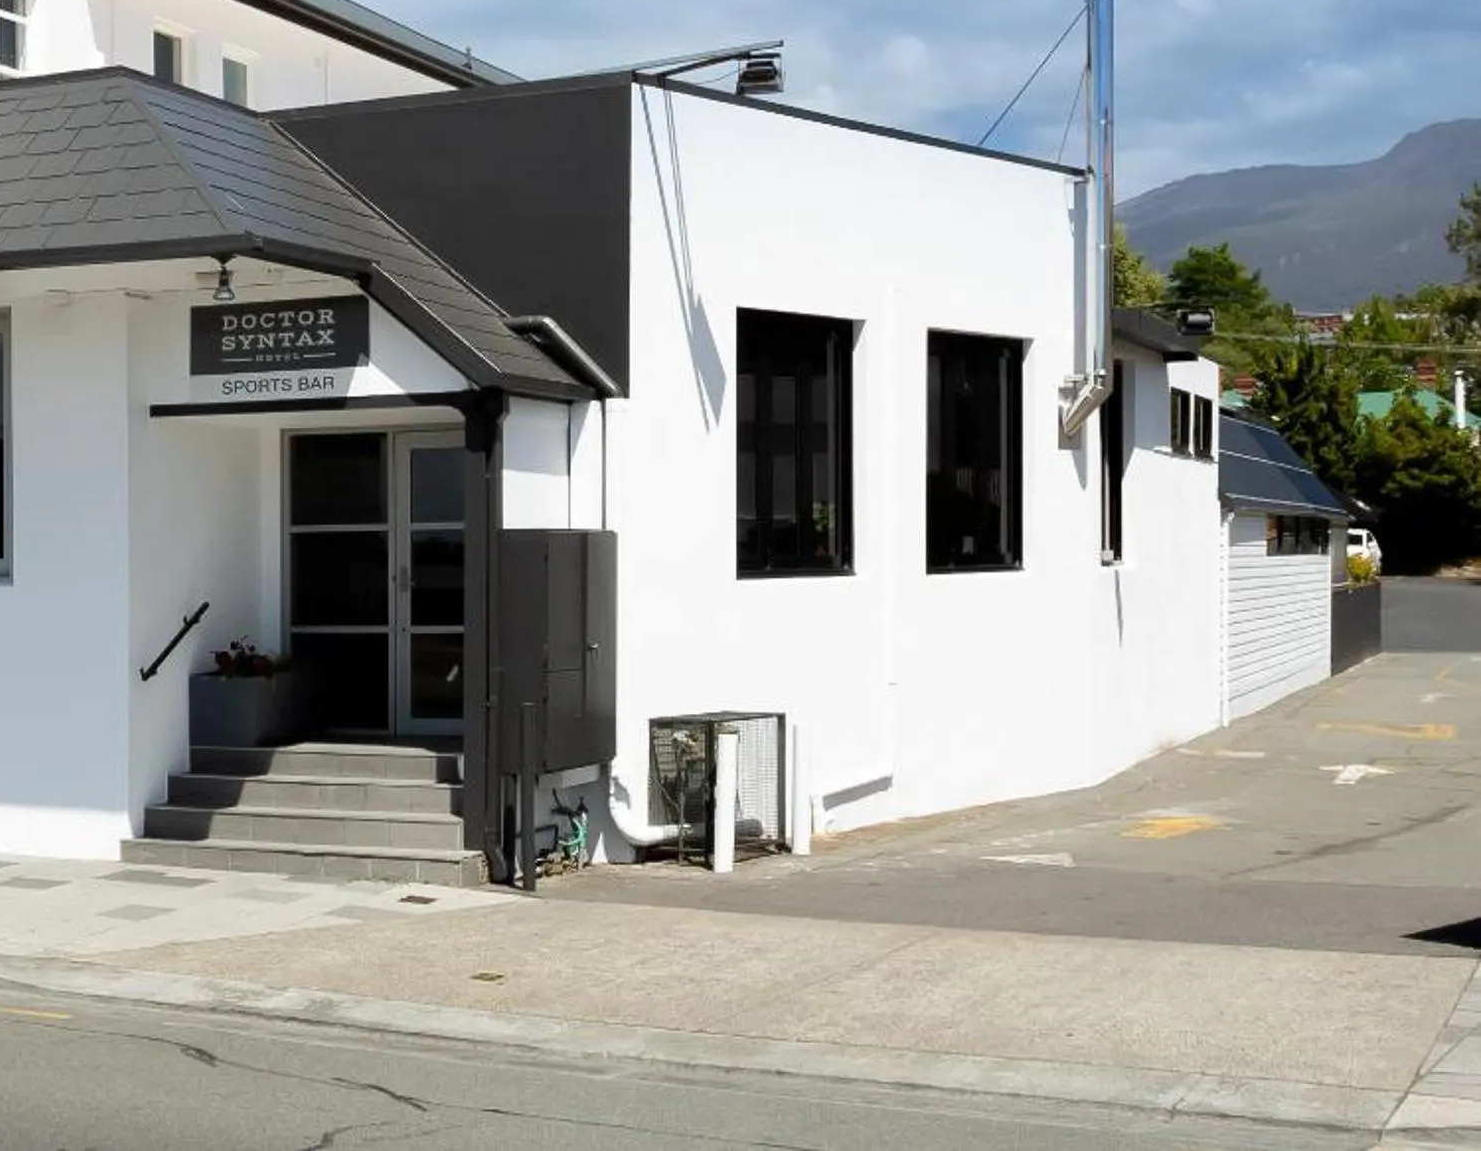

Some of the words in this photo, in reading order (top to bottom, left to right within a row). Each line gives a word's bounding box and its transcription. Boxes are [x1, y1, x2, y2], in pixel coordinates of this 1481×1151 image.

[222, 308, 337, 331] DOCTOR
[221, 329, 335, 351] SYNTAX
[255, 353, 301, 362] HOTEL
[221, 377, 293, 395] SPORTS
[298, 376, 335, 392] BAR
